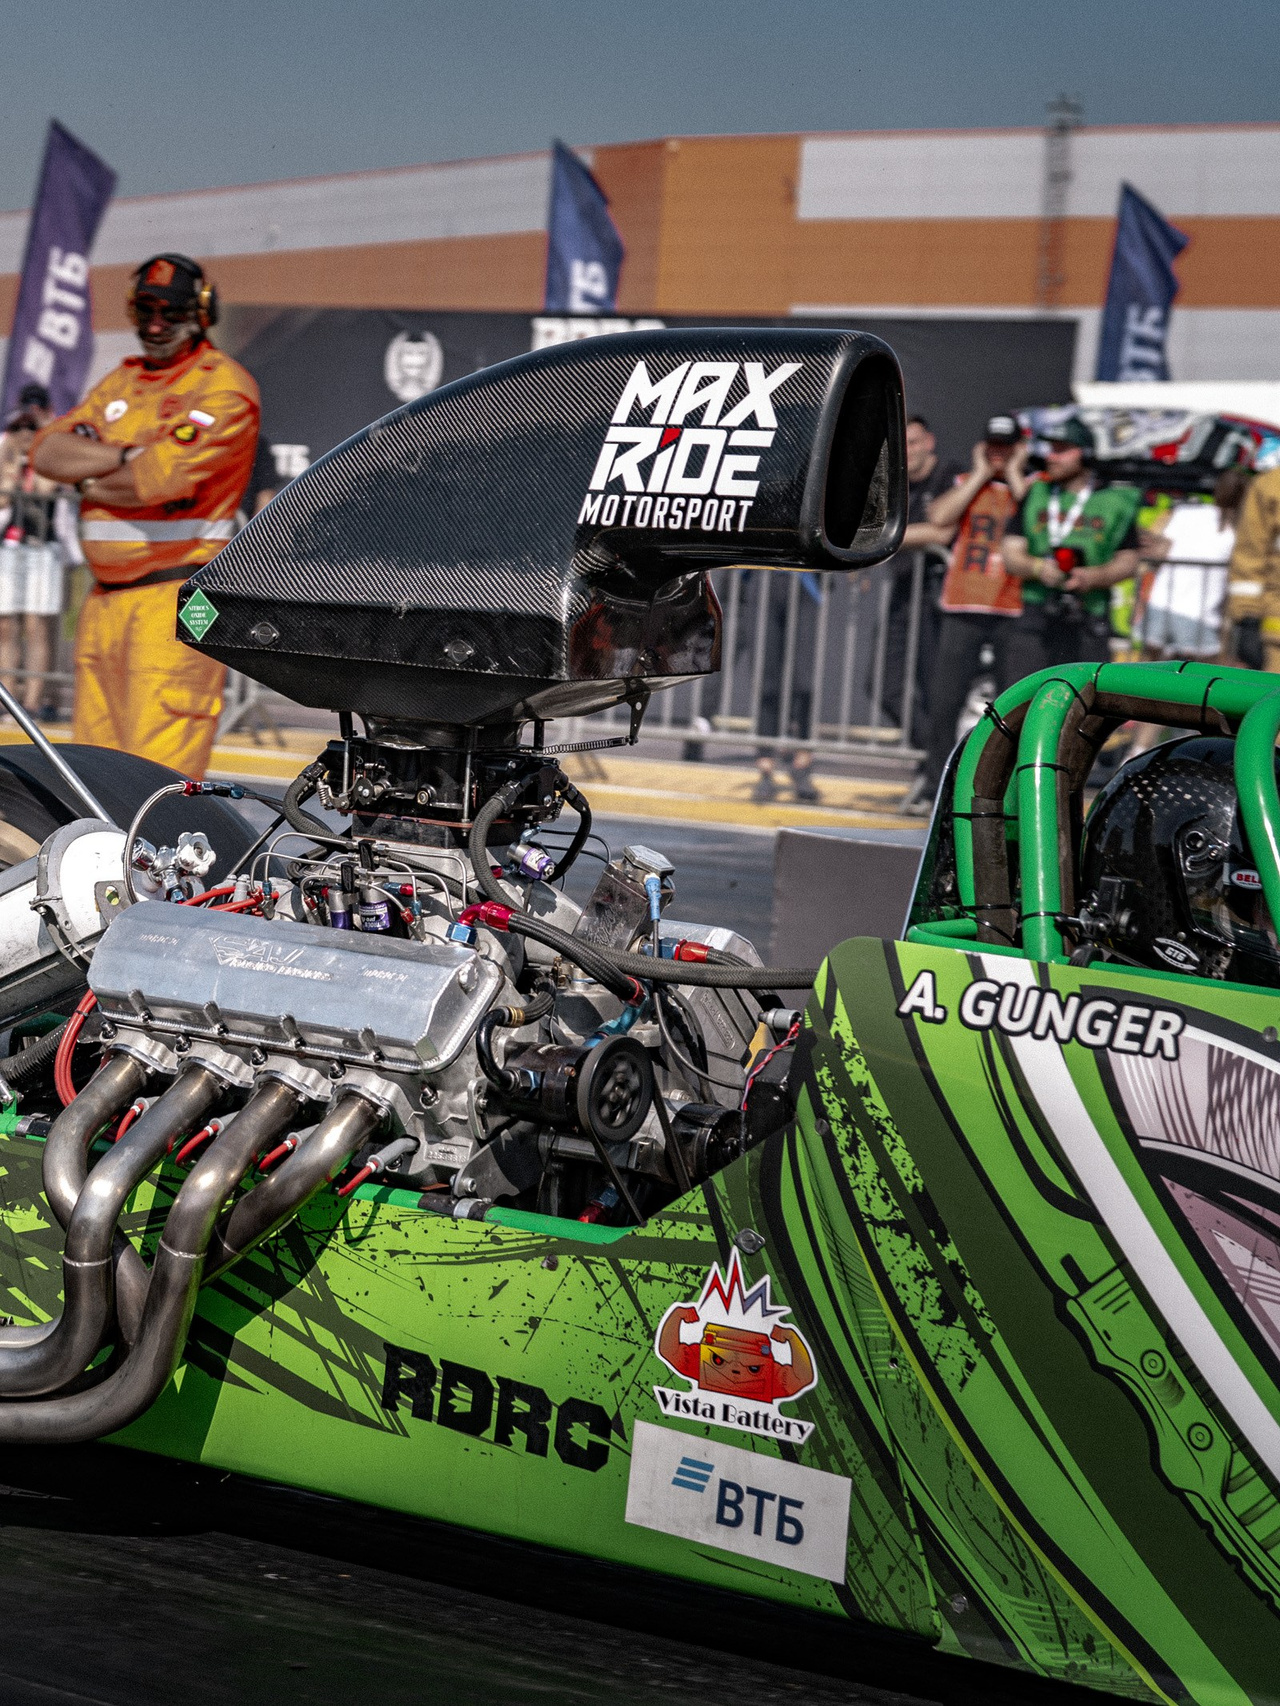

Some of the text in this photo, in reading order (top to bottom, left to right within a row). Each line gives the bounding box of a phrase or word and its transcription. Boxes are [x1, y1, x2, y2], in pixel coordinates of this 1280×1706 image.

[38, 247, 88, 349] ВТБ
[569, 258, 609, 313] ТБ
[610, 360, 803, 428] MAX
[577, 493, 753, 532] MOTORSPORT
[1236, 872, 1261, 884] BEL
[897, 970, 1184, 1059] A. GUNGER
[381, 1342, 612, 1472] RDRC
[658, 1390, 811, 1439] Vista Battery
[715, 1477, 805, 1546] ВТБ
